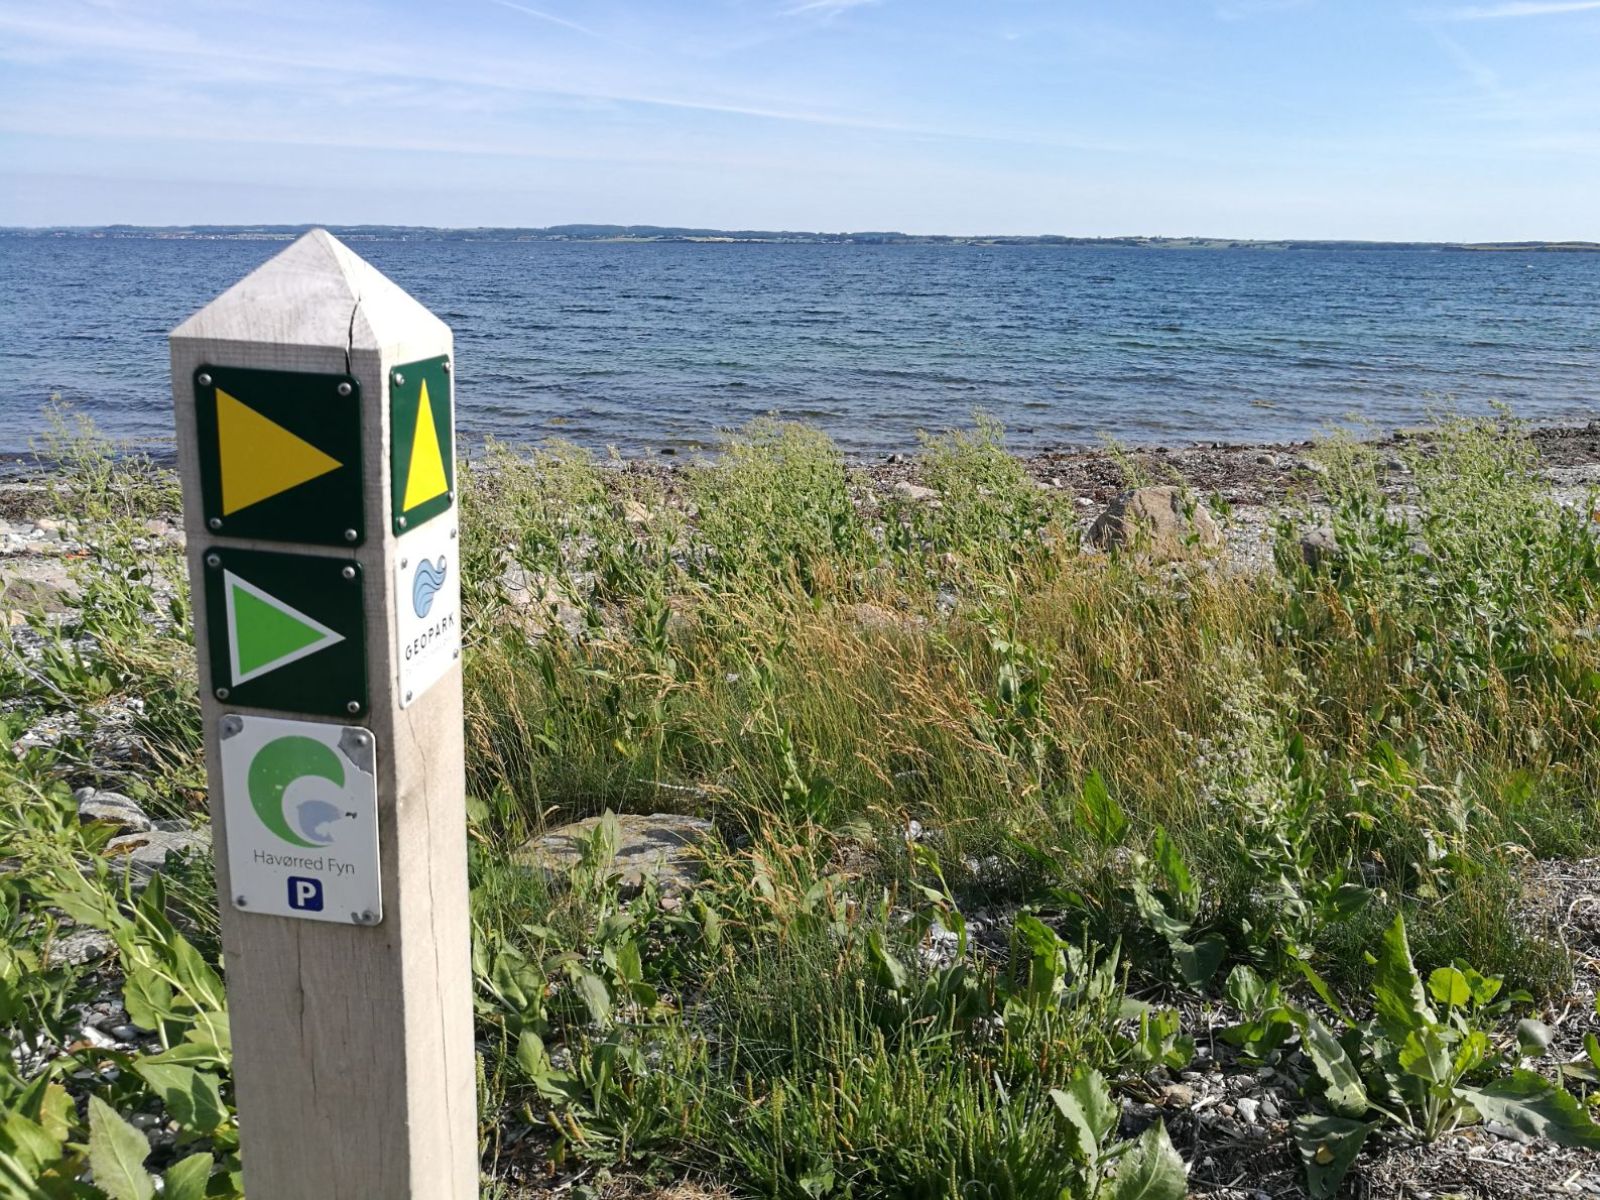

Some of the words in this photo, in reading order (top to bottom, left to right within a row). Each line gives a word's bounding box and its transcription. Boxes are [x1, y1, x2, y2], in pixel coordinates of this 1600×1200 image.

[405, 612, 454, 661] GEOPARK
[254, 849, 323, 871] Havørred
[328, 858, 355, 876] Fyn
[296, 881, 317, 907] P
